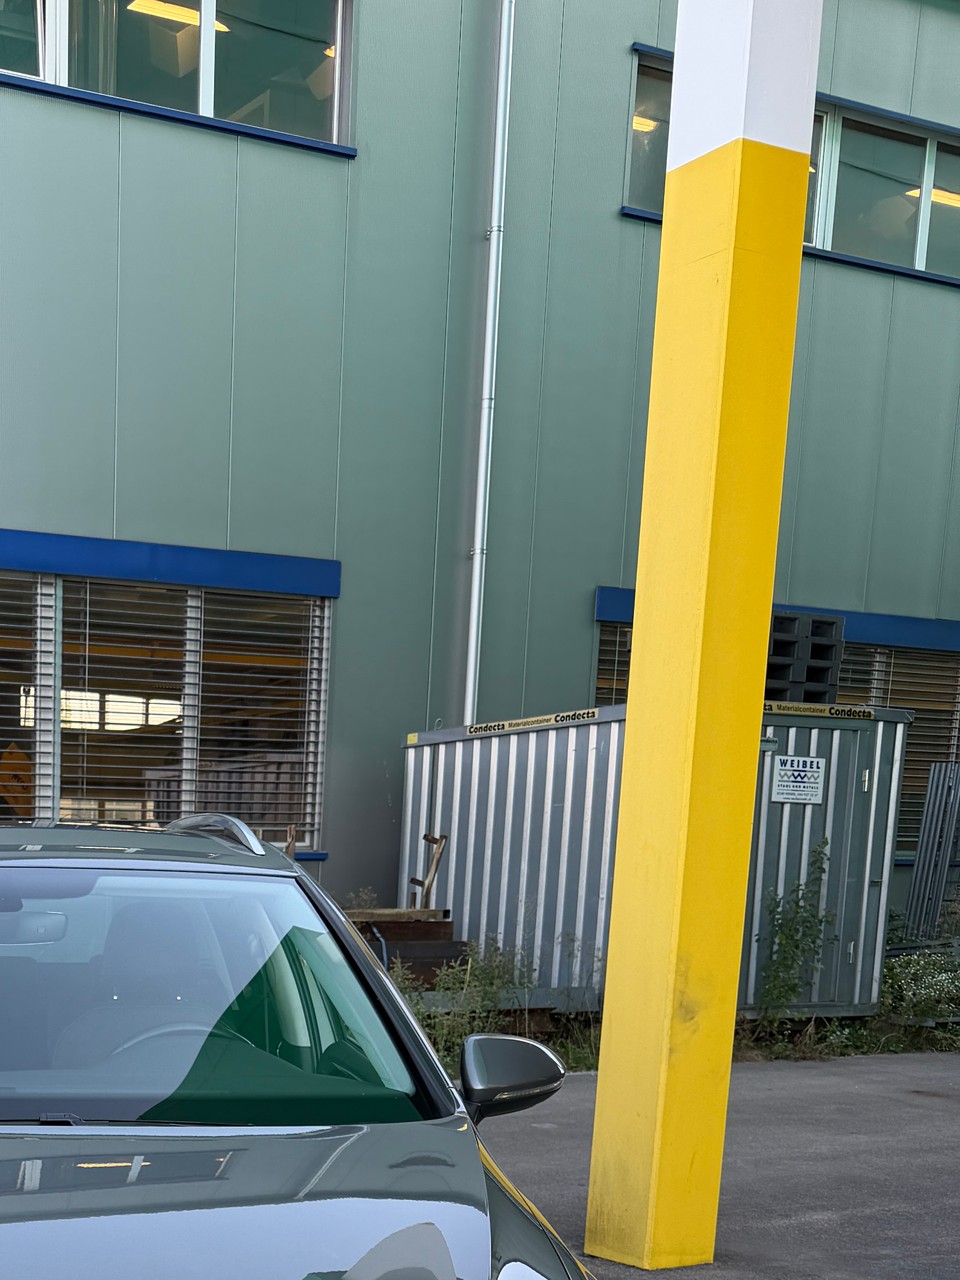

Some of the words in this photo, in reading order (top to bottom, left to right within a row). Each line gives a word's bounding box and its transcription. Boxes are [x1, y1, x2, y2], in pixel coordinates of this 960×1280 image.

[776, 704, 826, 714] Materialcontainer
[828, 706, 872, 718] Condecta
[468, 722, 506, 734] Condecta
[507, 716, 553, 729] Materialcontainer
[554, 710, 596, 723] Condecta
[779, 758, 821, 770] WEIBEL
